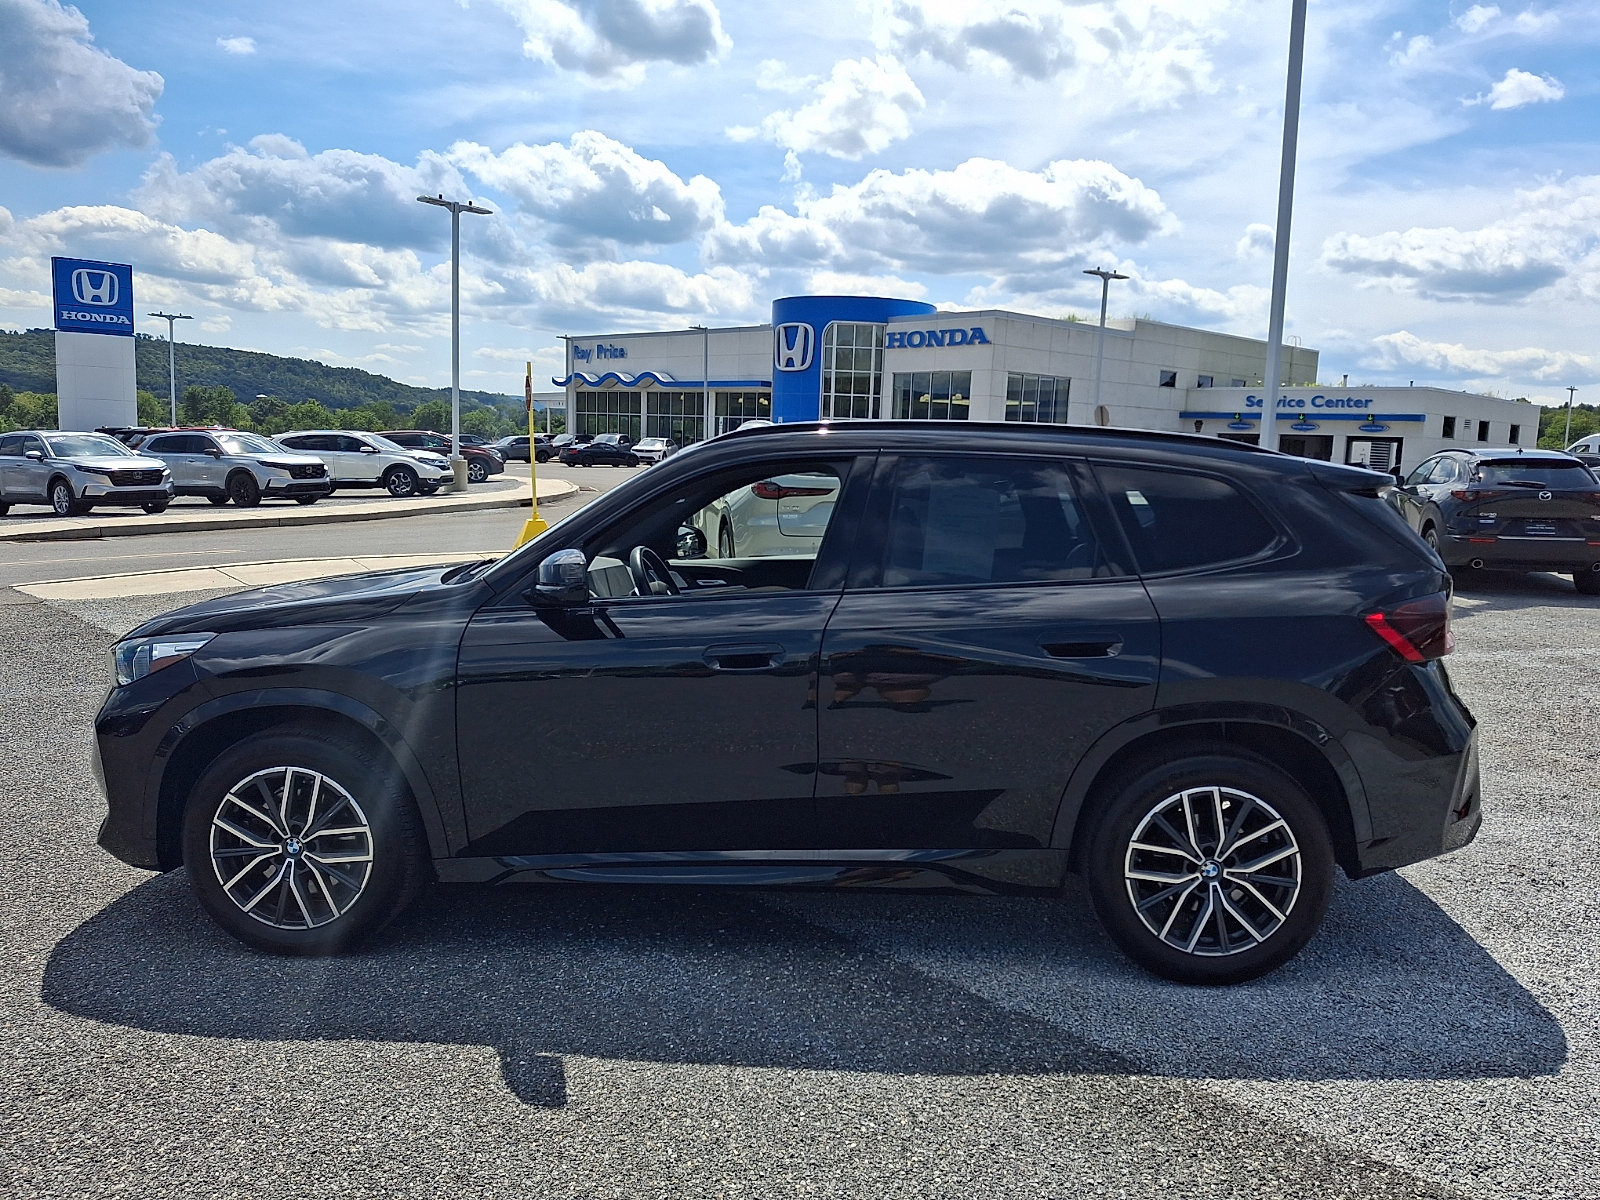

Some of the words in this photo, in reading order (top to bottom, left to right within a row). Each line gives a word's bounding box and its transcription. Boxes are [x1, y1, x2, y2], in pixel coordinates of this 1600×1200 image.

[61, 311, 131, 324] HONDA
[886, 327, 990, 349] HONDA
[574, 345, 592, 364] Ray
[596, 343, 625, 359] Price
[1245, 395, 1306, 408] Seice
[1311, 395, 1373, 408] Center
